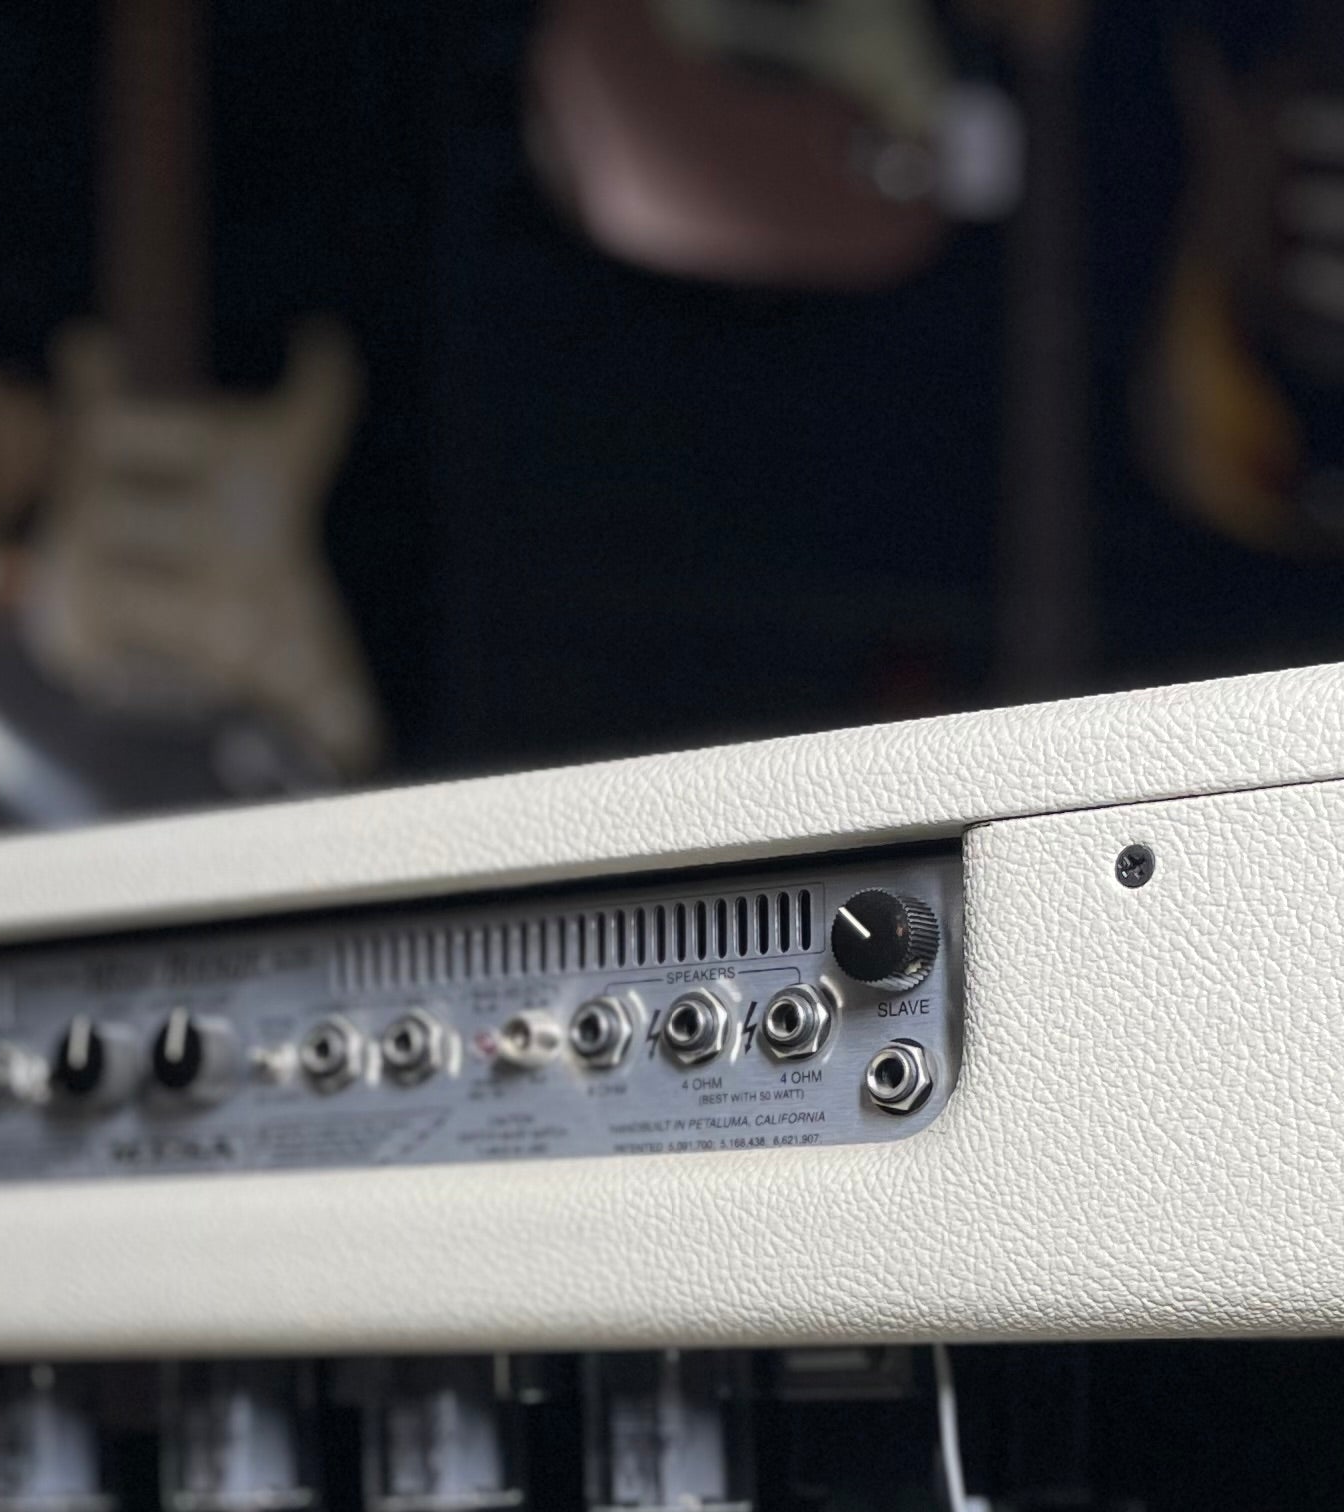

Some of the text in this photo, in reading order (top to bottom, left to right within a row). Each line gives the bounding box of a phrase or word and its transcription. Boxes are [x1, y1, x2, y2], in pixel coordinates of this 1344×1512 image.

[665, 966, 736, 985] SPEAKERS
[877, 1000, 930, 1018] SLAVE
[682, 1077, 723, 1090] 4 OHM
[780, 1070, 823, 1085] 4 OHM
[699, 1088, 805, 1106] (BEST WITH 50 WATT)
[673, 1118, 686, 1131] IN
[755, 1111, 826, 1127] CALIFORNIA
